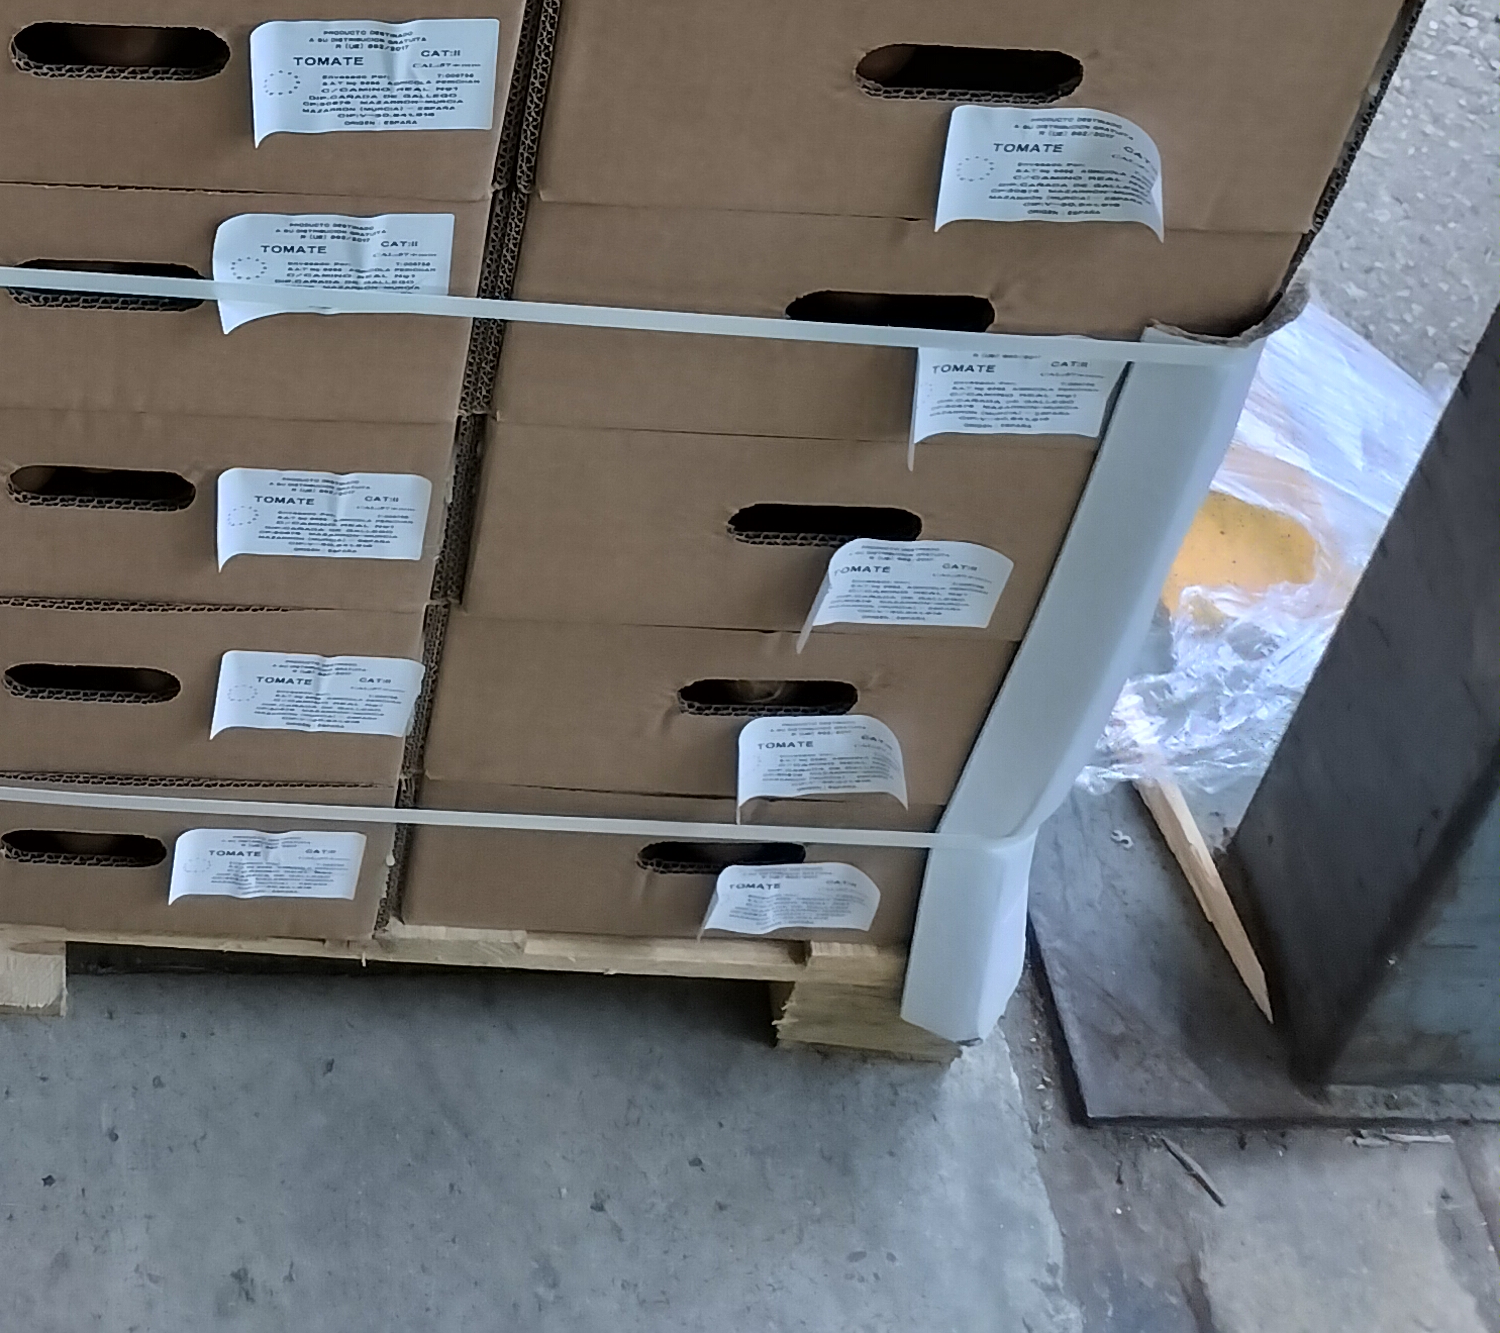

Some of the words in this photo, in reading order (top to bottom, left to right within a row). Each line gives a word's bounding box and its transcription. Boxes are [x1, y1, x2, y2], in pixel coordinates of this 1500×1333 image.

[293, 57, 364, 66] TOMATE
[993, 143, 1064, 153] TOMATE
[260, 245, 327, 253] TOMATE
[932, 364, 997, 374] TOMATE
[254, 495, 315, 505] TOMATE
[834, 565, 891, 577] TOMATE
[256, 676, 313, 686] TOMATE
[757, 740, 814, 750] TOMATE
[209, 849, 262, 857] TOMATE
